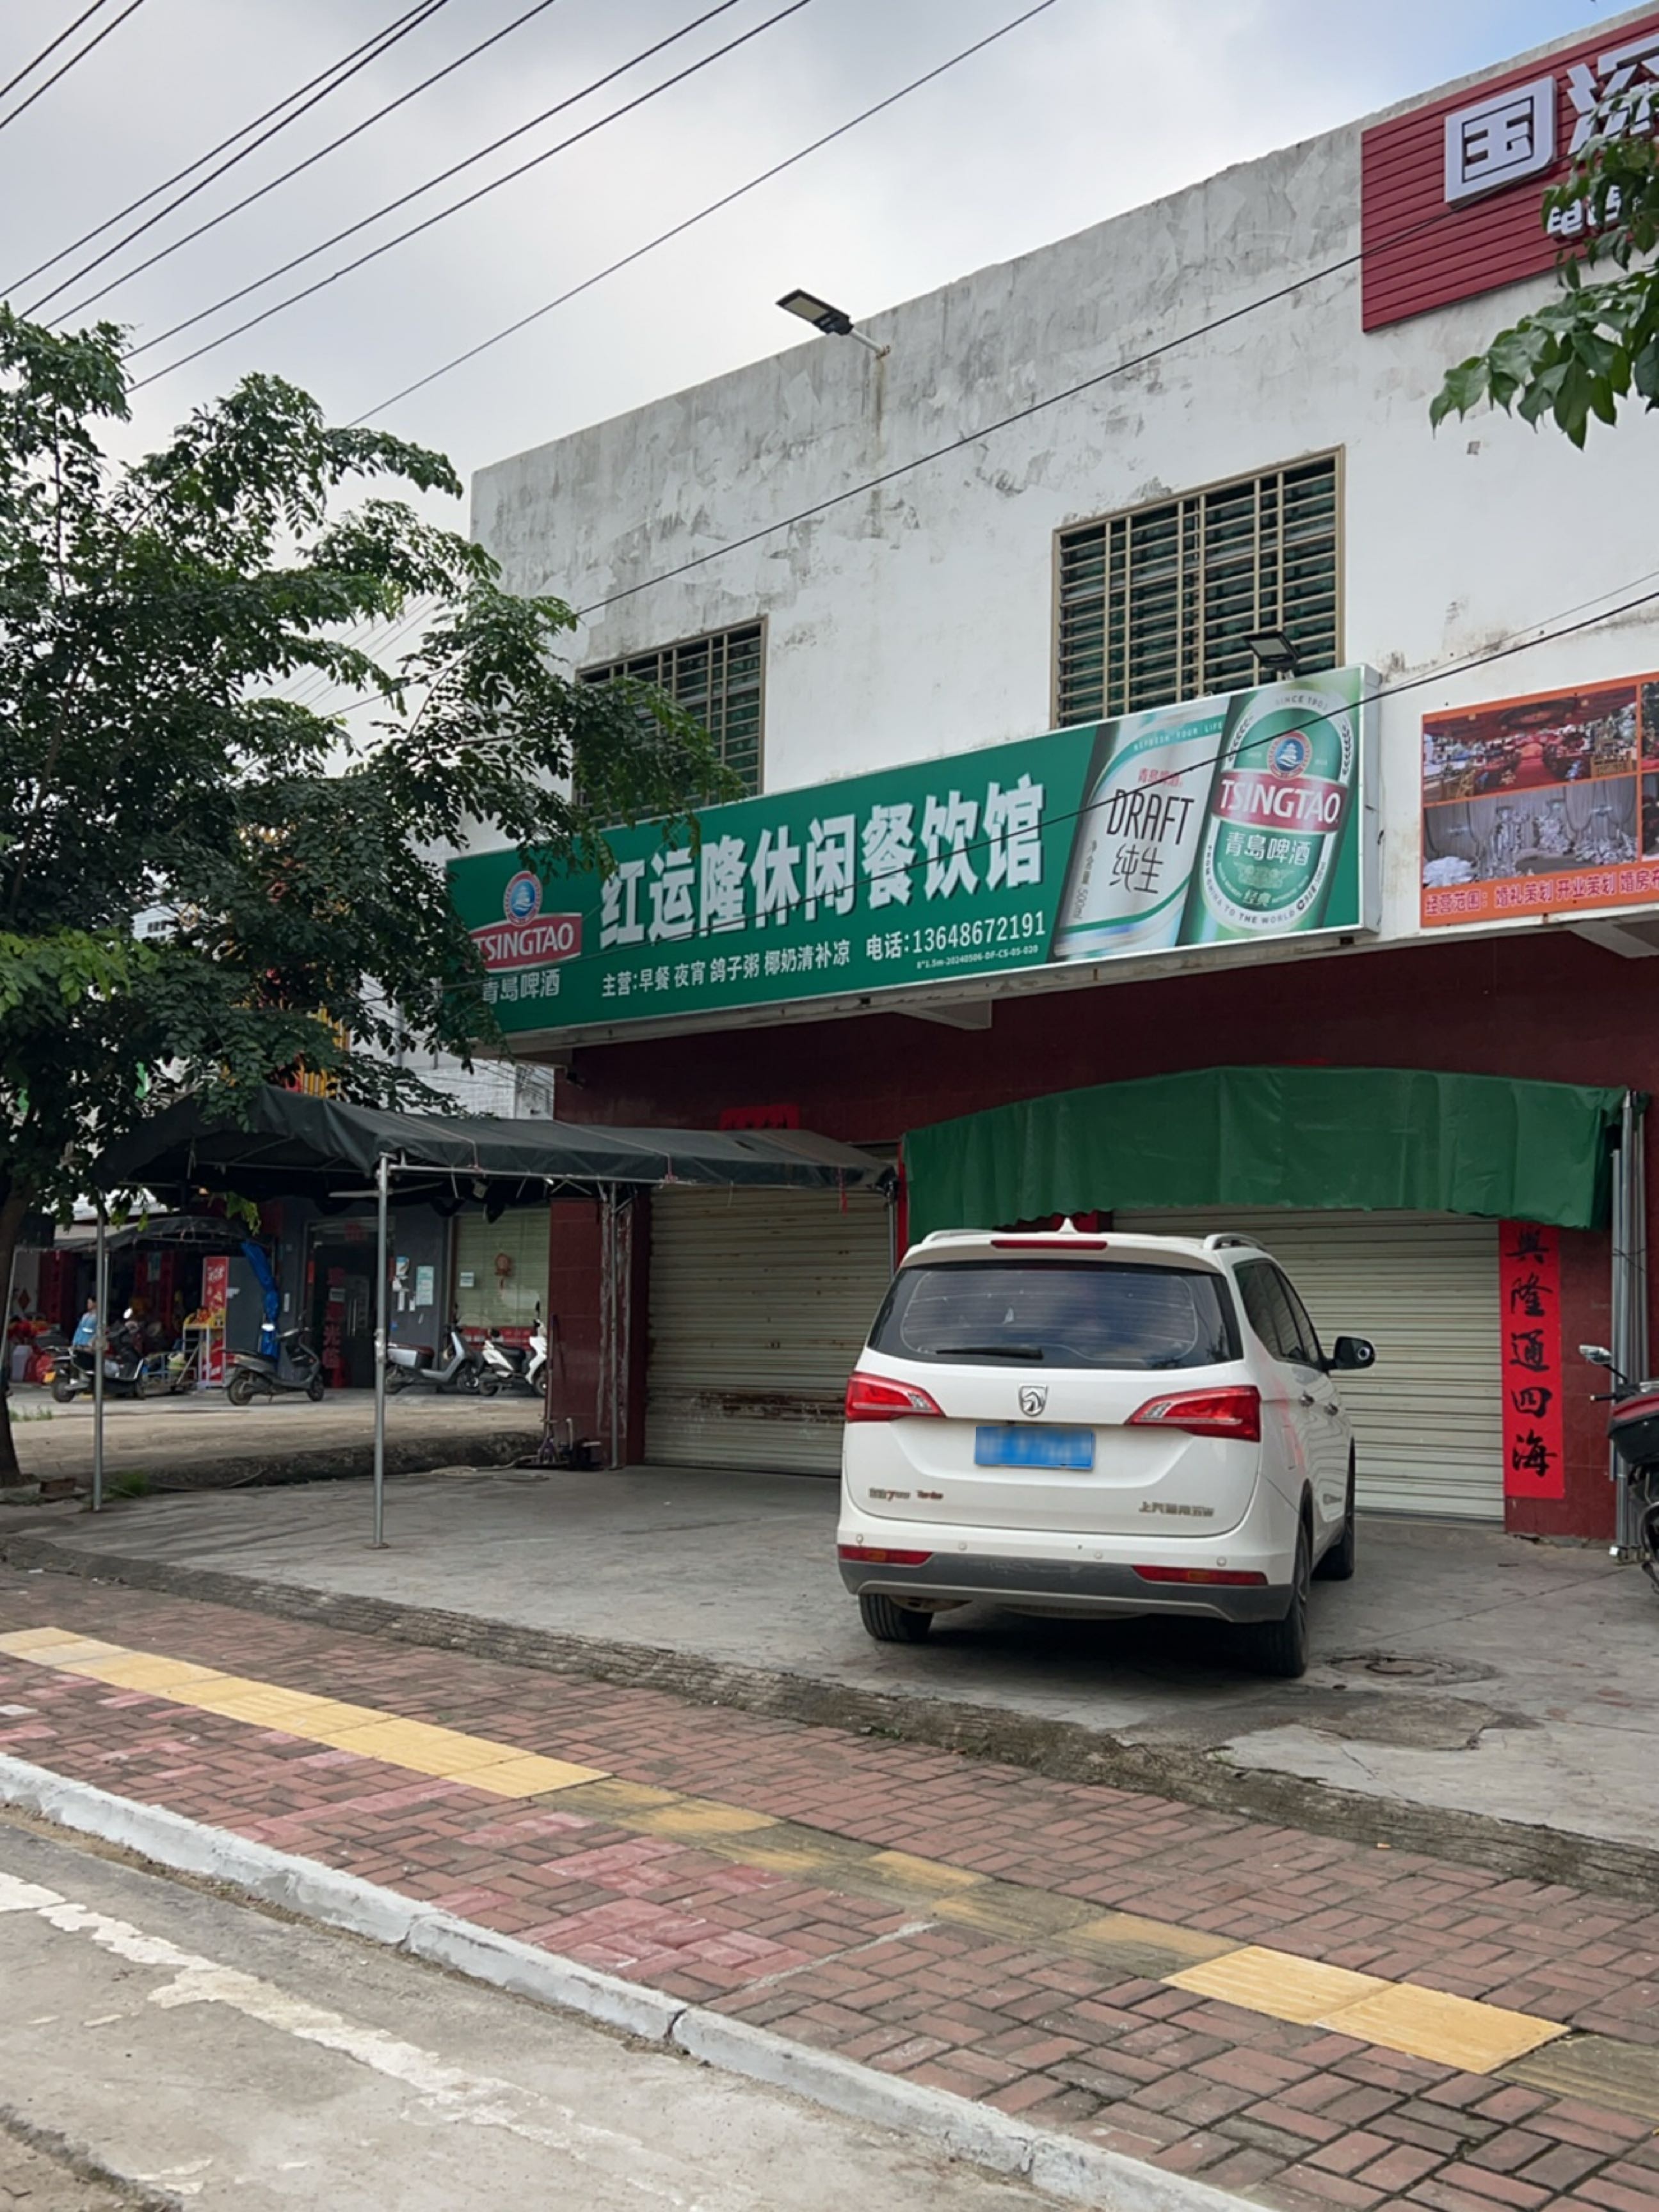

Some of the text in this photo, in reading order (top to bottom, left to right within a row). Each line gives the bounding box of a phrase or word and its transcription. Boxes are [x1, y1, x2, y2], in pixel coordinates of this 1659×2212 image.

[1106, 789, 1194, 845] DRAFT
[1220, 779, 1340, 823] TSINGTAO
[600, 773, 1043, 949] 红运隆休闲餐饮馆
[1109, 843, 1164, 894] 纯生
[471, 922, 573, 962] TSINGTAO
[866, 910, 1046, 961] 电话:13648672191
[674, 960, 705, 988] 夜宵
[710, 952, 760, 982] 鸽子粥
[764, 939, 851, 976] 椰奶清补凉
